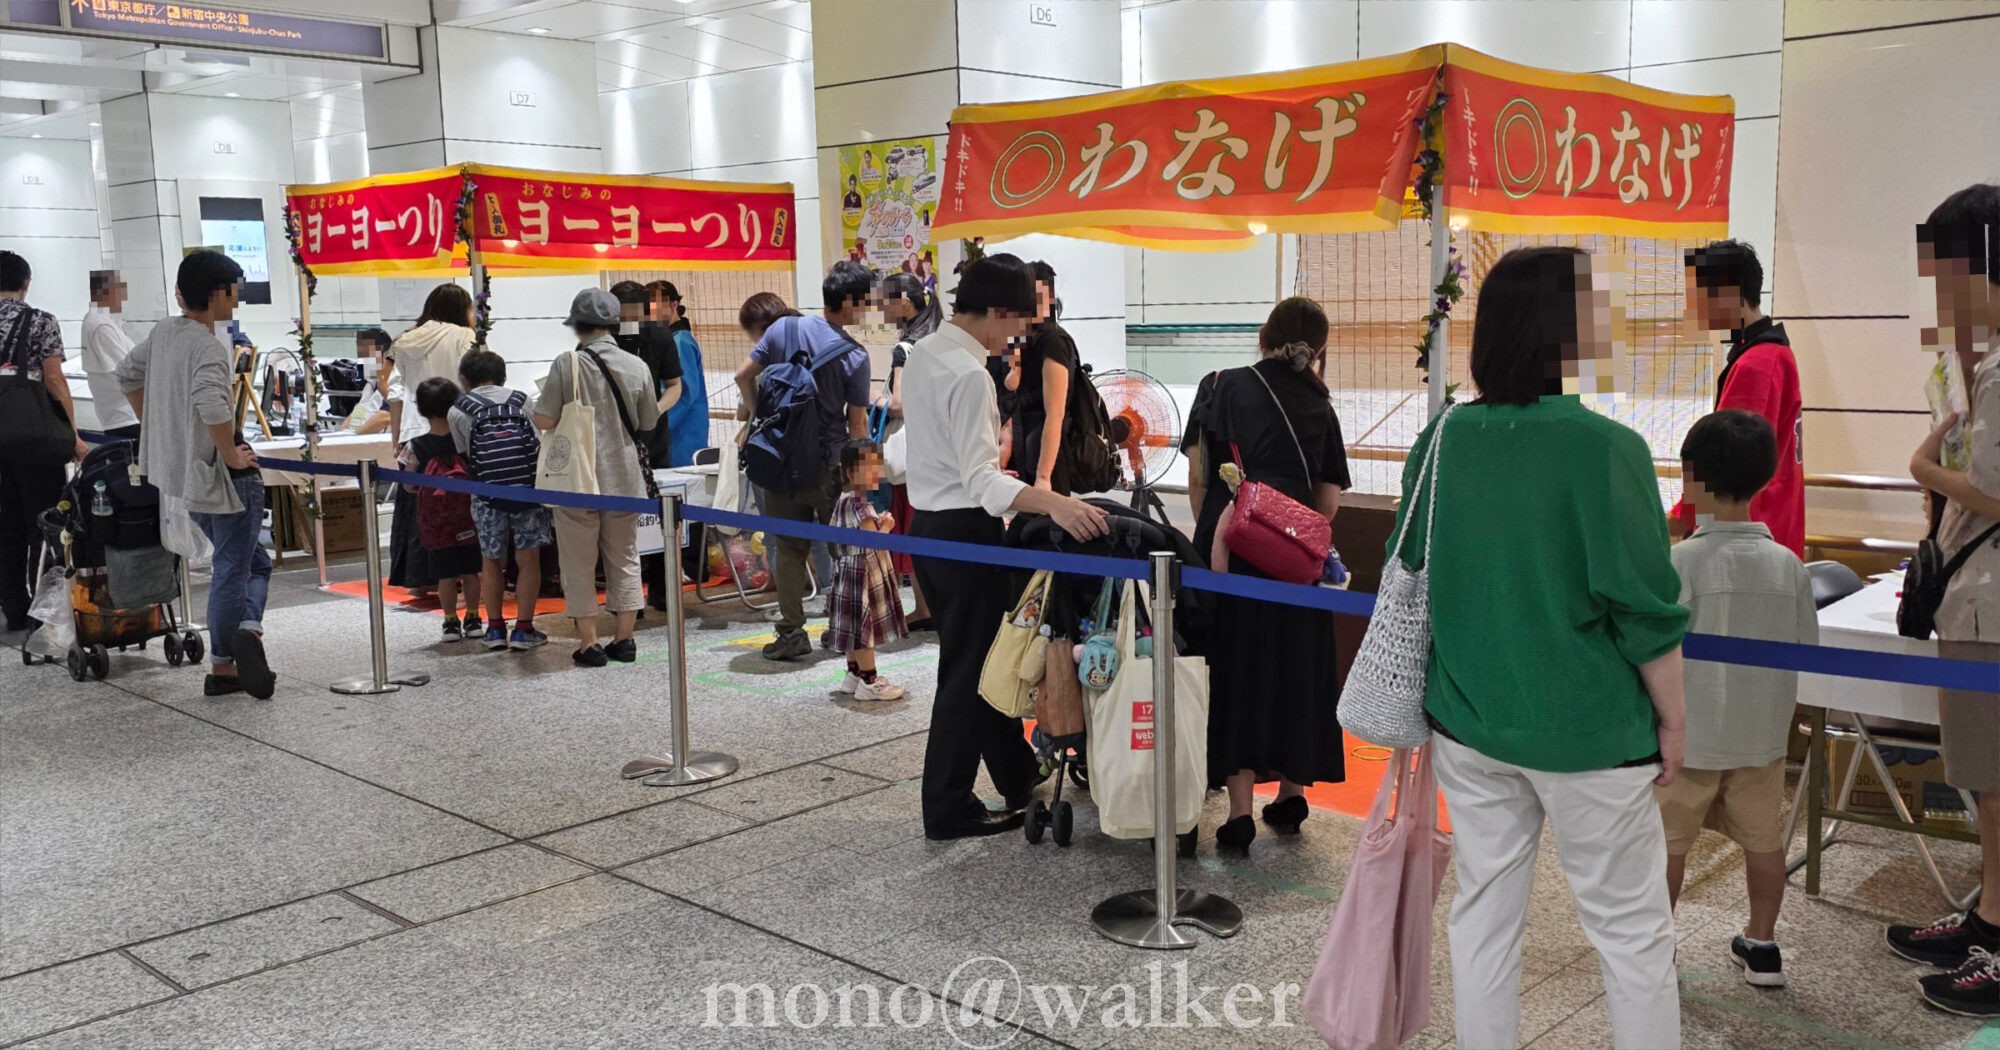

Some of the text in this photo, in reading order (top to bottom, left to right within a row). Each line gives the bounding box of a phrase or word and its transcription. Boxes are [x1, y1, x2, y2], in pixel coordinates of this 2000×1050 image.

[94, 11, 116, 20] Tokyo
[118, 14, 166, 25] Metropolitan
[167, 19, 211, 30] Government
[1037, 7, 1051, 22] D6
[516, 93, 529, 103] D7
[1068, 92, 1367, 204] わなげ
[1555, 105, 1702, 211] わなげ
[522, 182, 611, 200] おなじみの
[954, 133, 972, 212] ドキドキ!!
[310, 194, 354, 209] おなじみの
[307, 193, 443, 254] ヨーヨーつり
[518, 199, 762, 258] ヨーヨーつり
